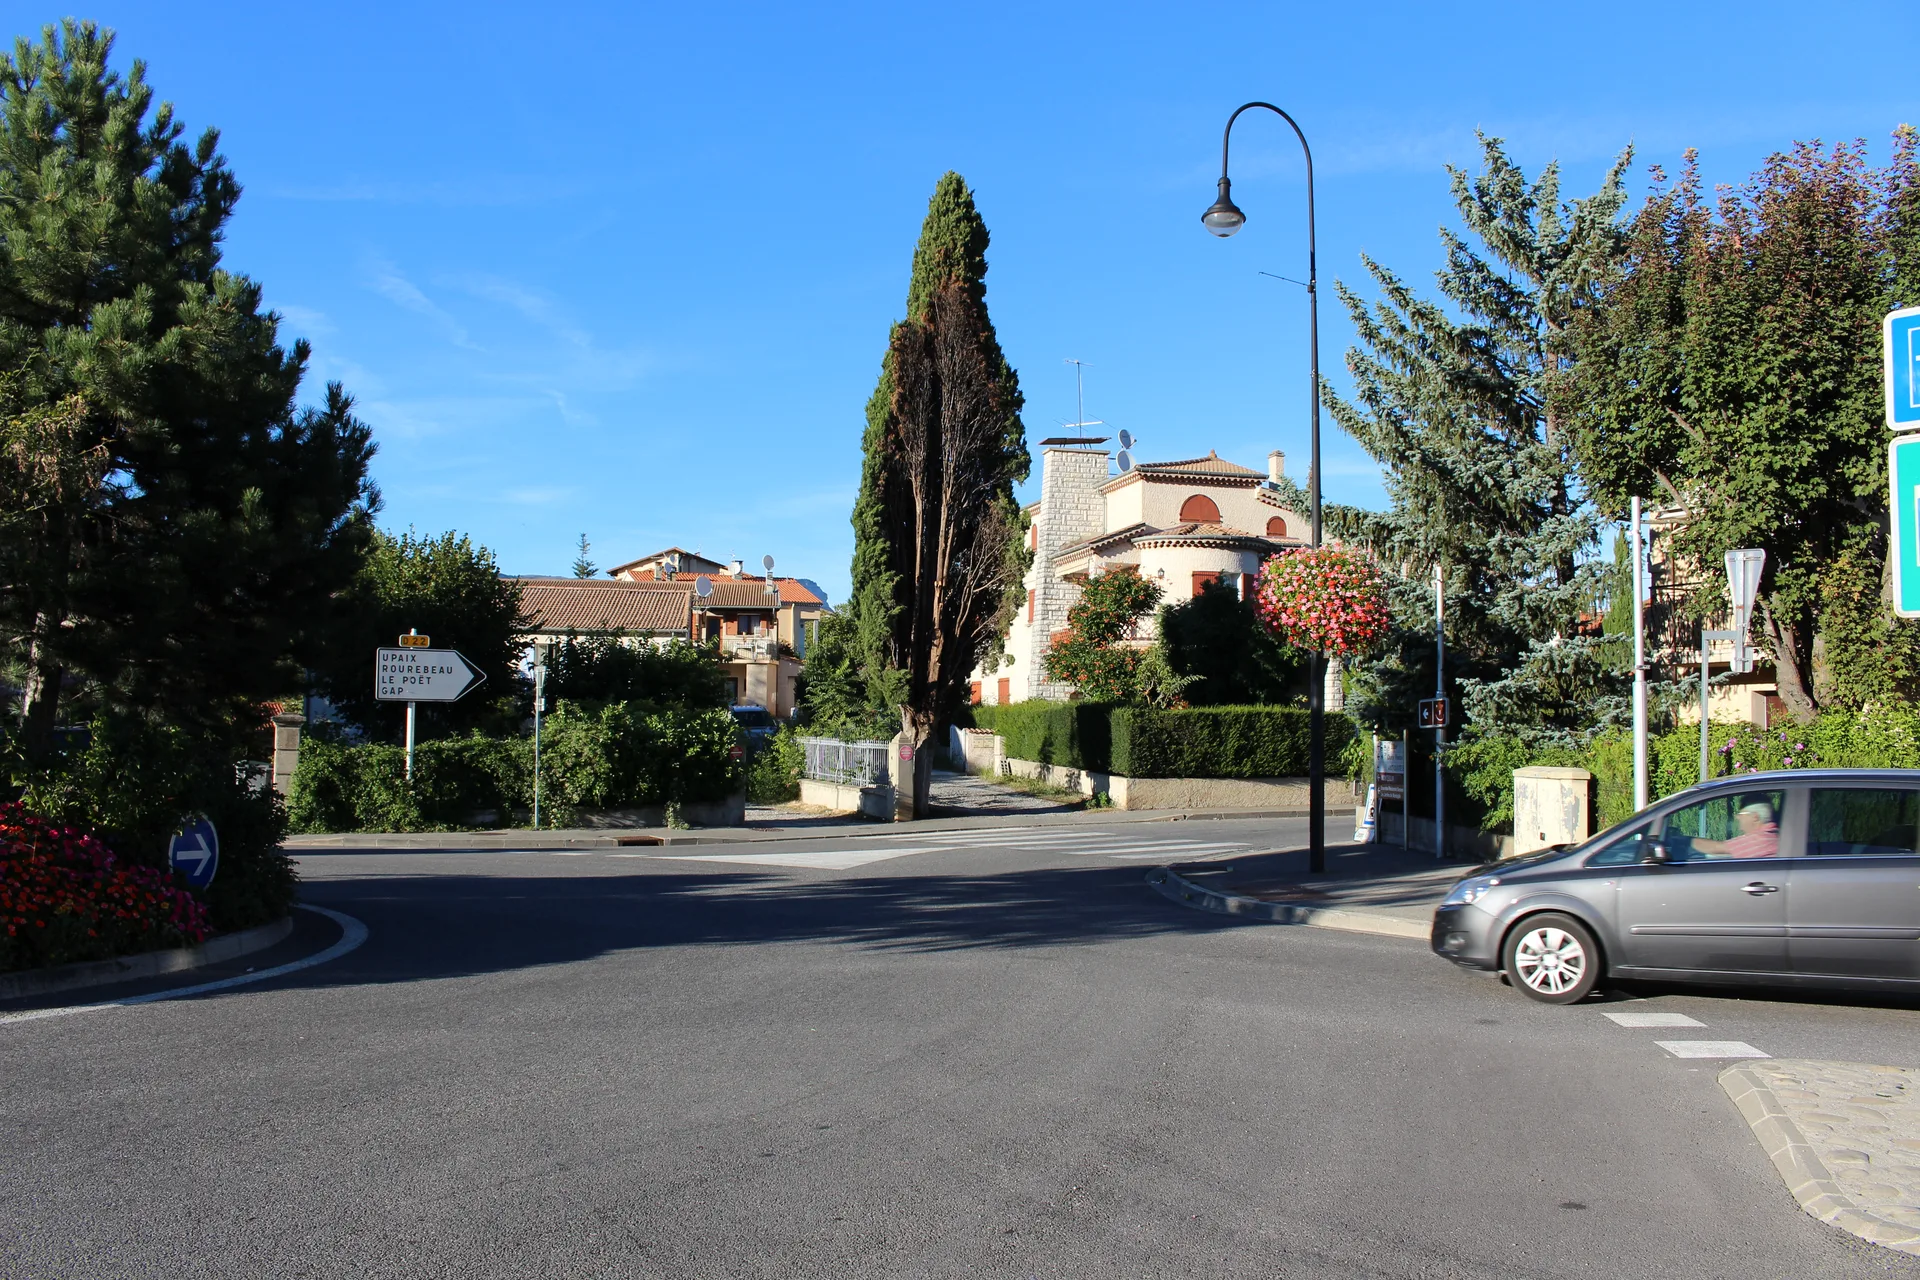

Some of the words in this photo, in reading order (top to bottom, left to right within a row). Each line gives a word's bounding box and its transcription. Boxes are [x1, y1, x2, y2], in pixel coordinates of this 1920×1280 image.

[403, 637, 408, 645] D
[412, 637, 426, 645] 22
[382, 653, 417, 662] UPAIX
[382, 665, 453, 674] ROUREBEAU
[382, 676, 394, 684] LE
[402, 675, 432, 684] POËT
[382, 687, 404, 695] GAP
